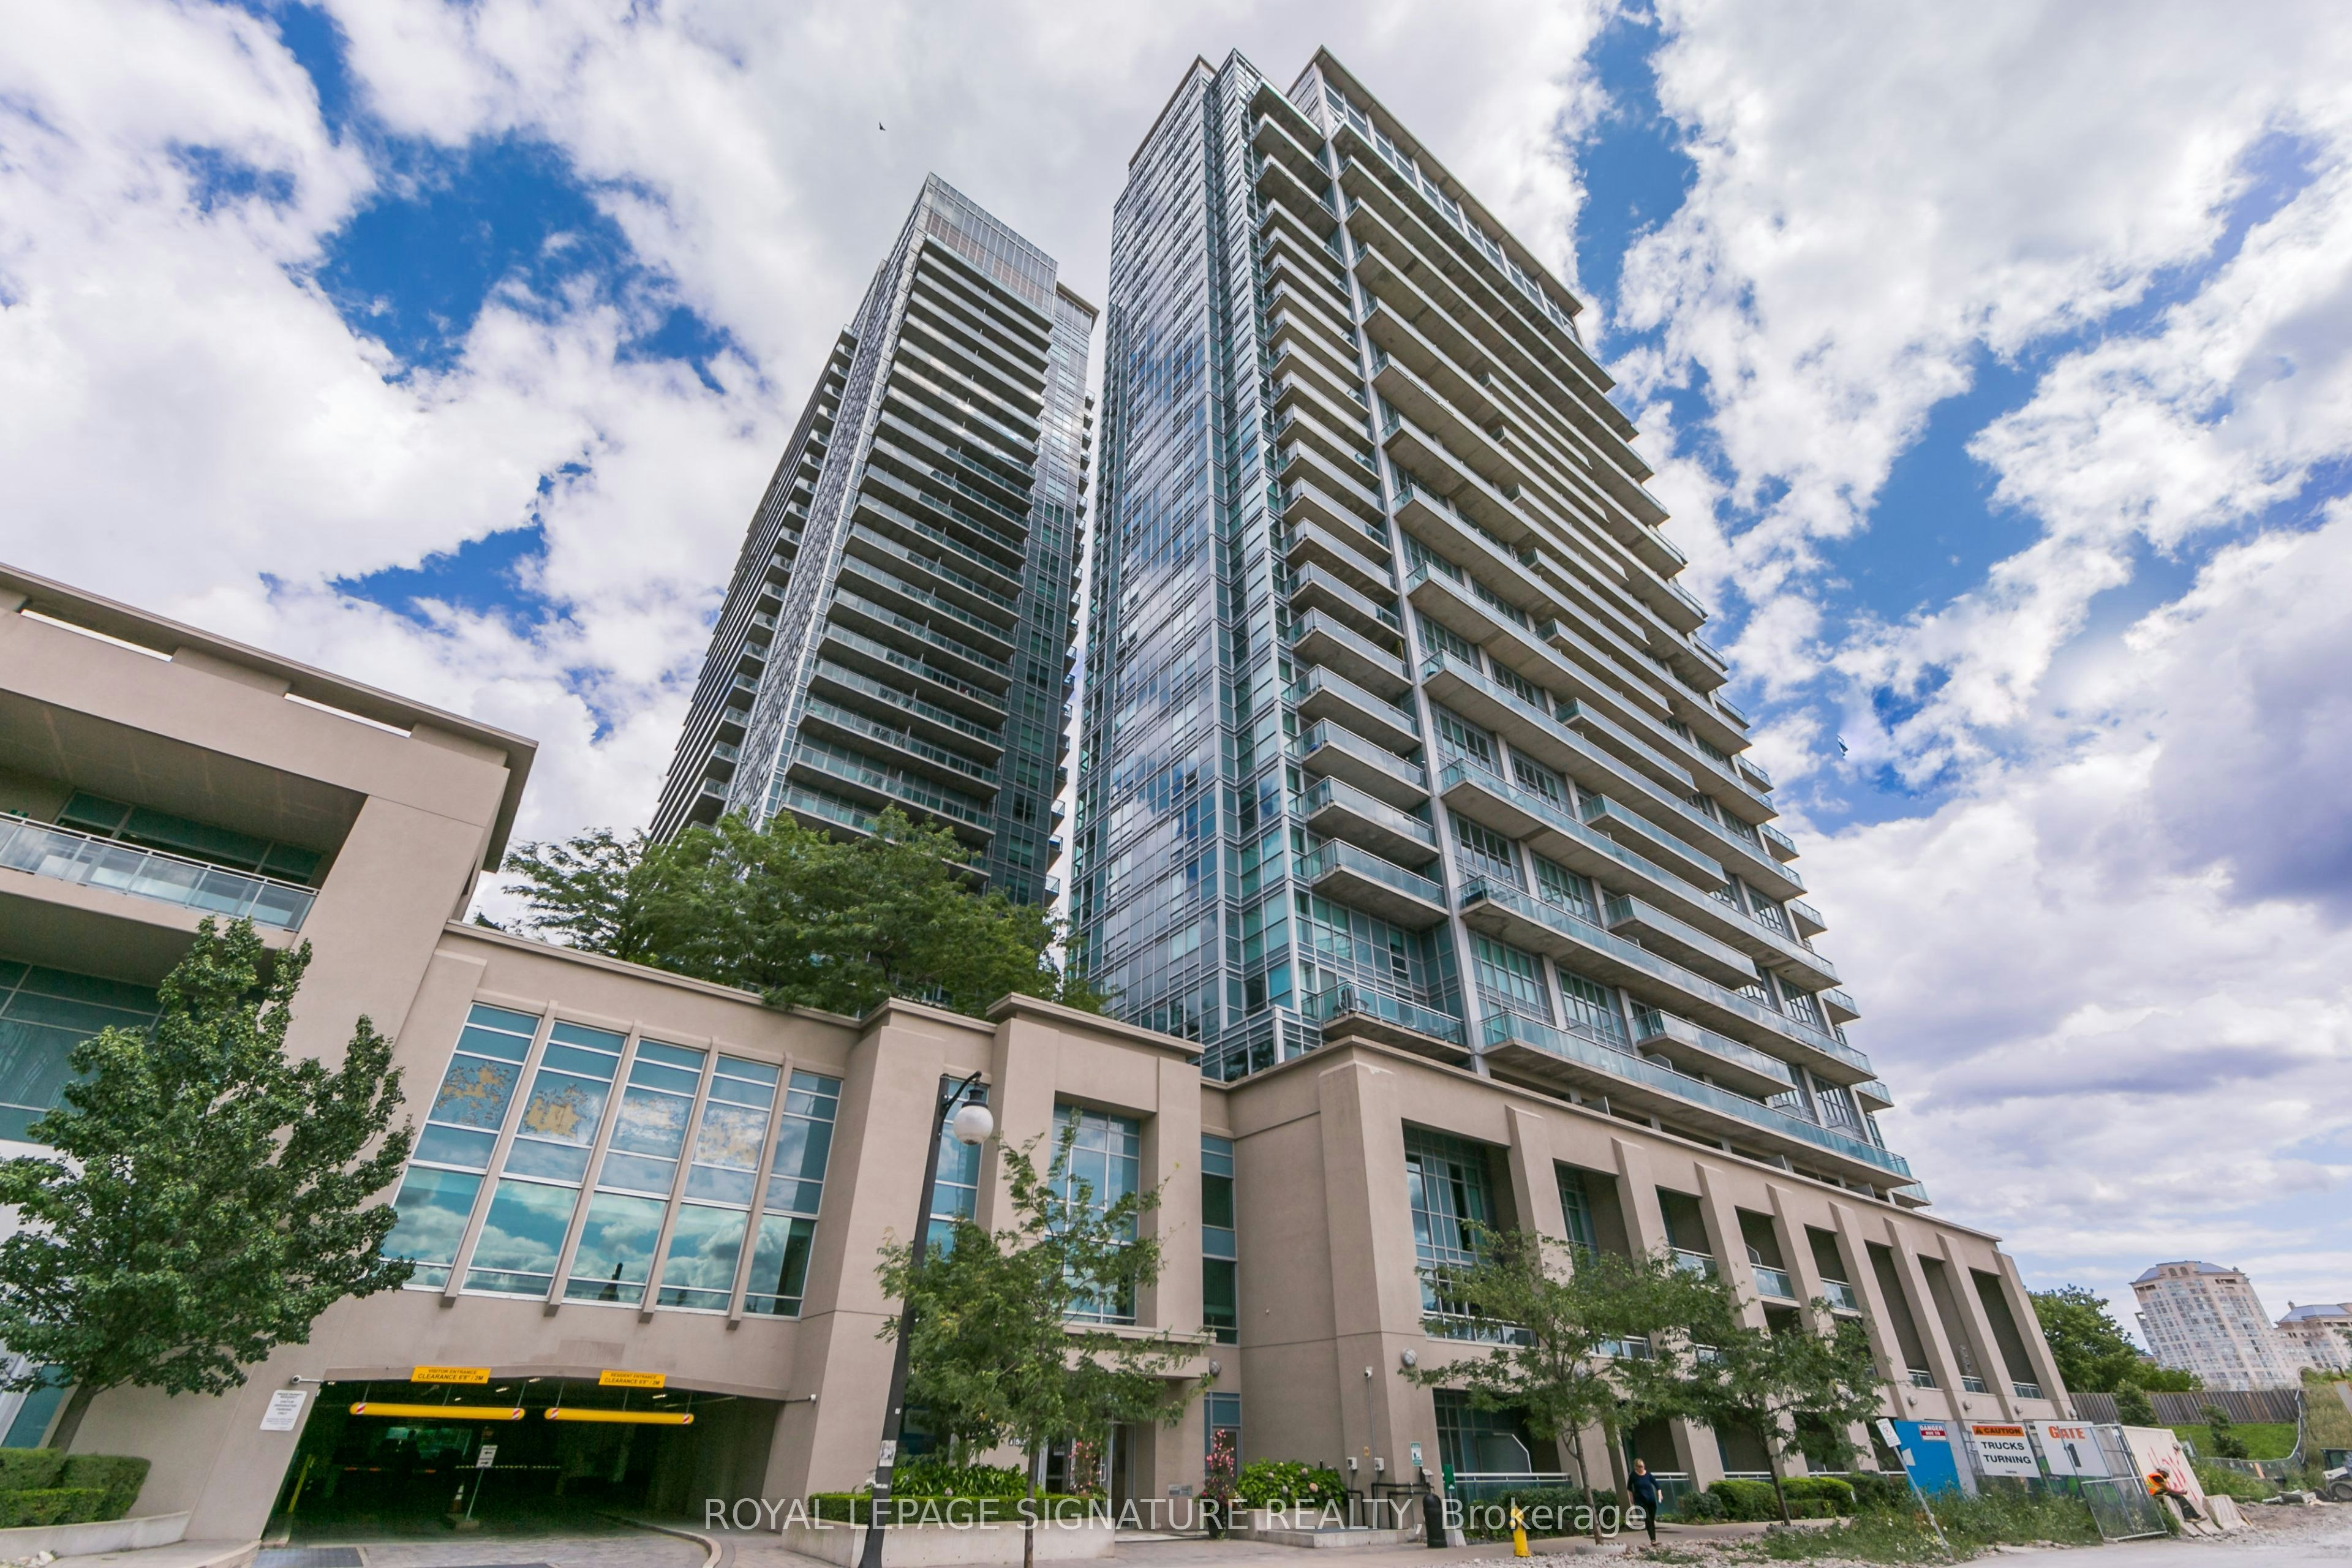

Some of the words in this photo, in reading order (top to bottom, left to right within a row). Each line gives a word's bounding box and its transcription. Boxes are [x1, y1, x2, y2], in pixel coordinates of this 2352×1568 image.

[2048, 1426, 2086, 1439] GATE
[1981, 1441, 2024, 1450] TRUCKS
[1983, 1455, 2032, 1464] TURNING
[2064, 1443, 2082, 1468] 1
